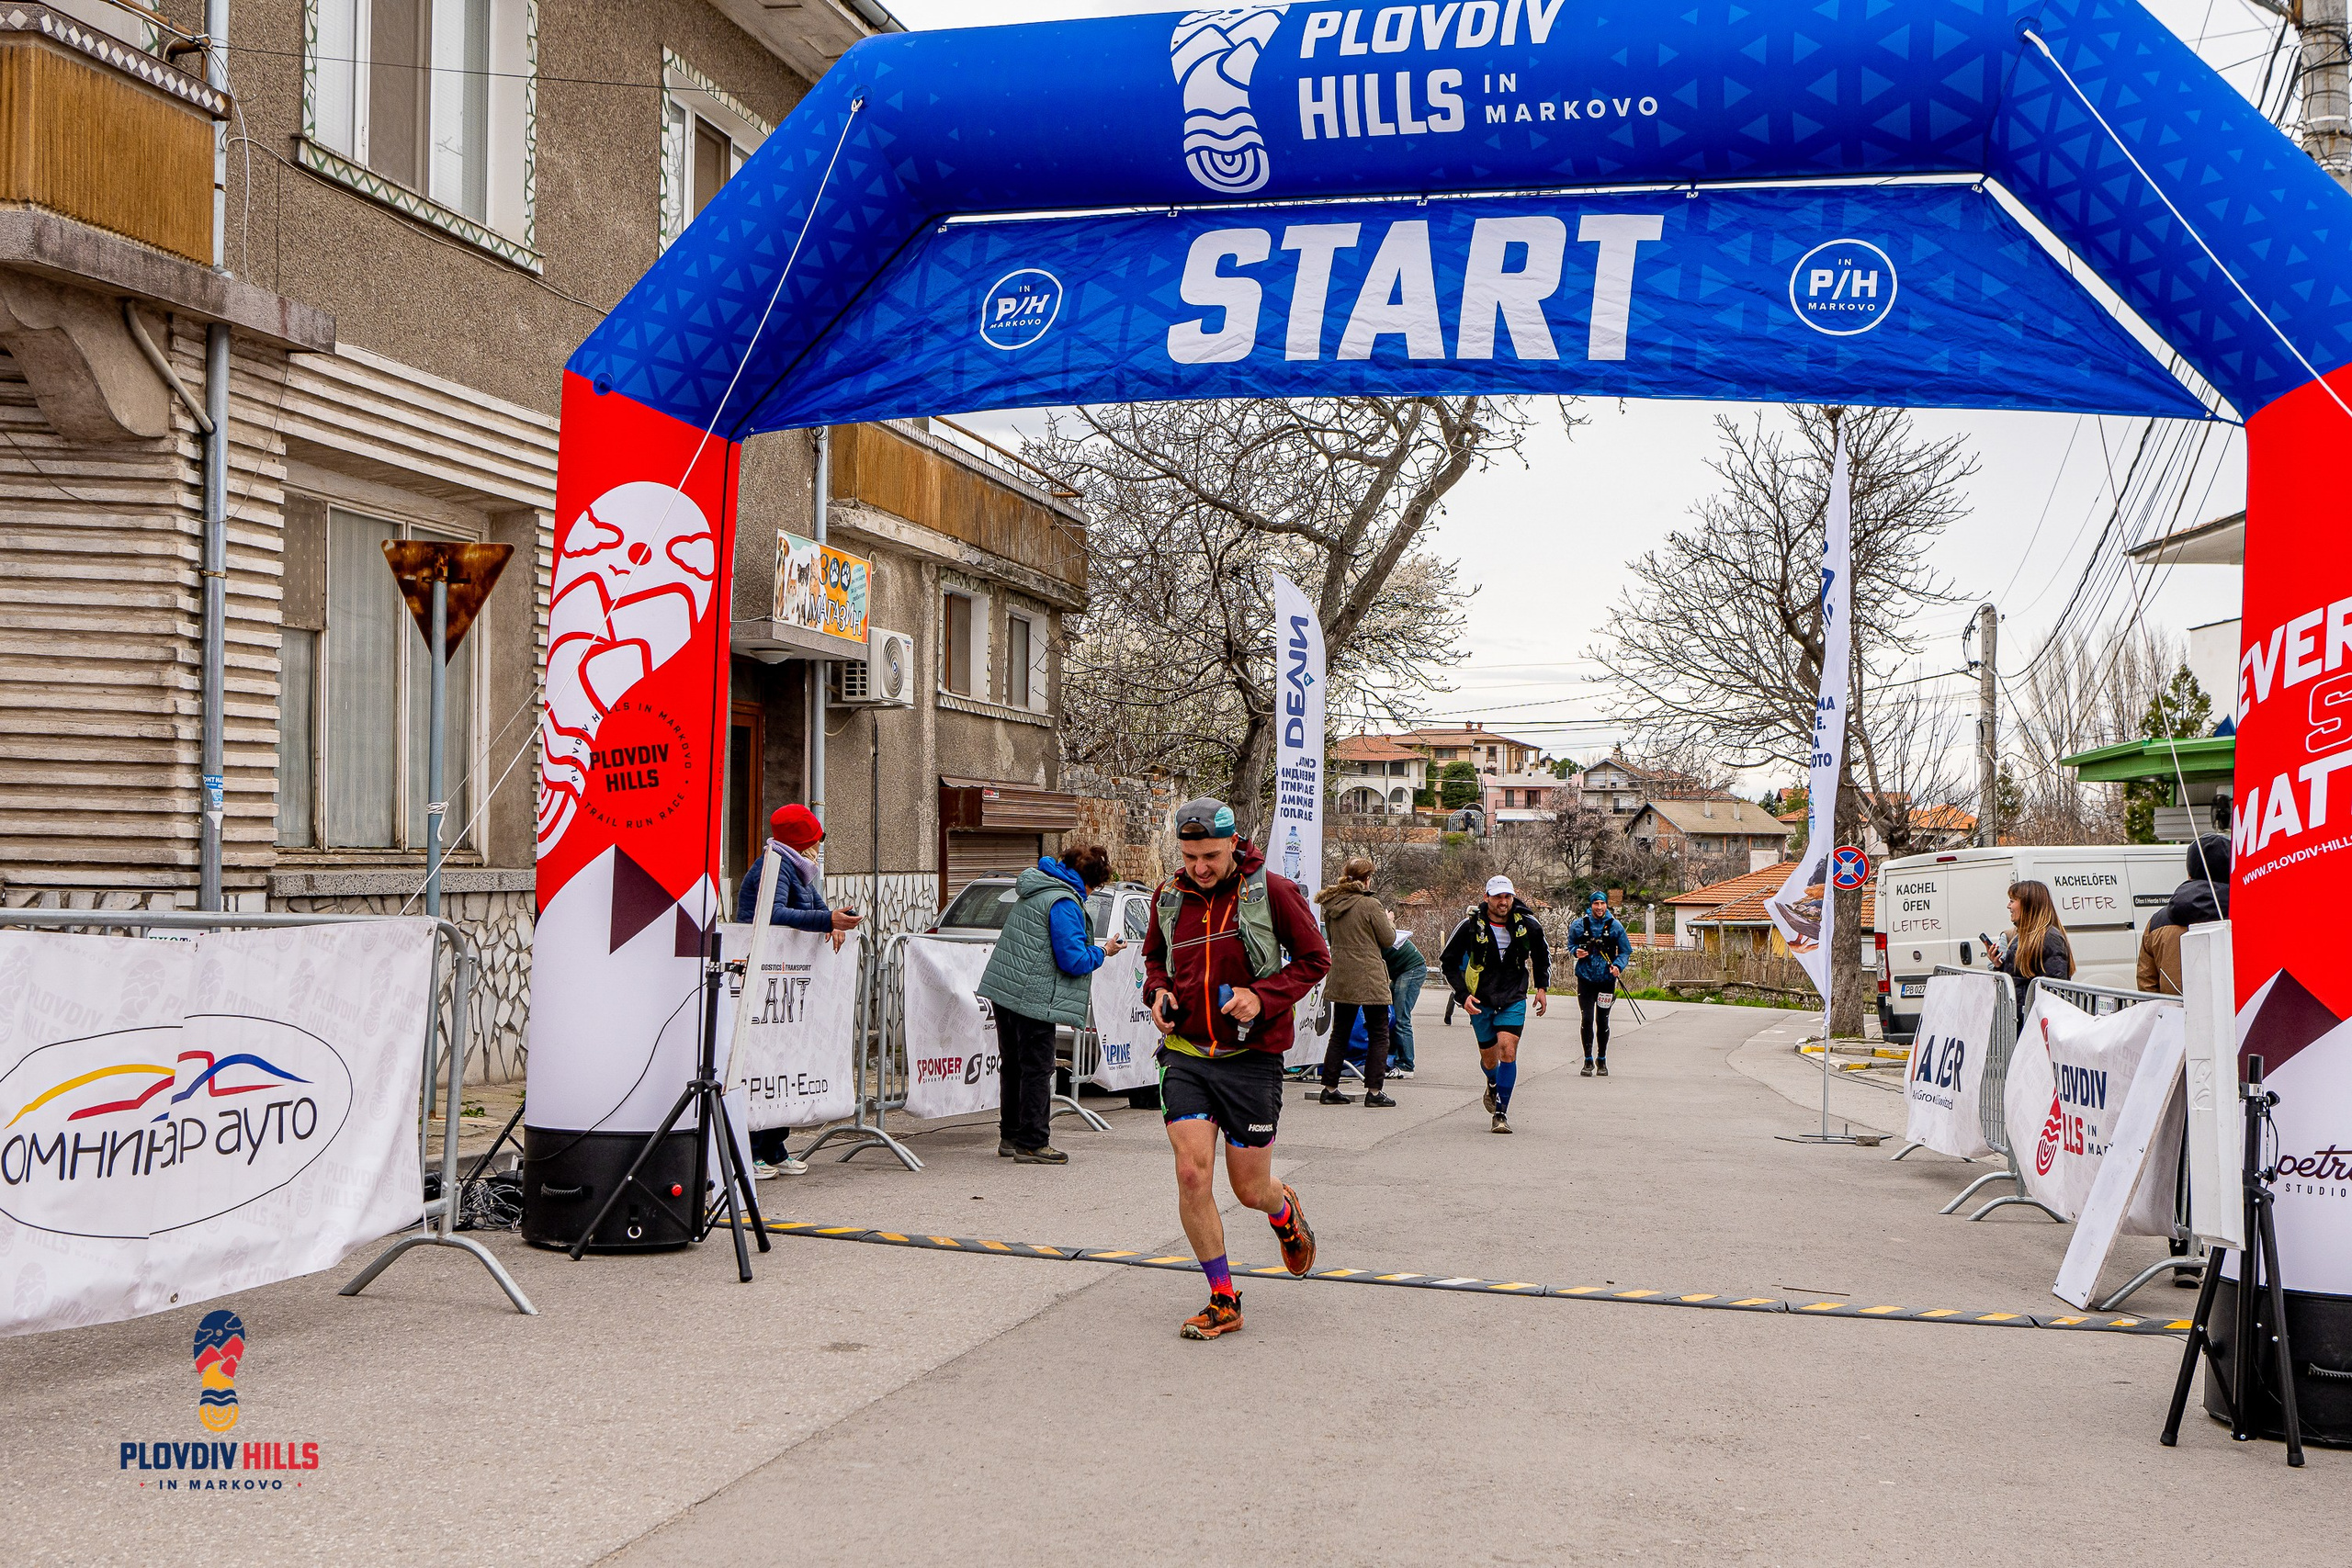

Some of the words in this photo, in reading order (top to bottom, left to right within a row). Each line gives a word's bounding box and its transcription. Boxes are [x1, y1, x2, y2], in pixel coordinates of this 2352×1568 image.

[1299, 0, 1564, 59] PLOVDIV
[1484, 73, 1517, 94] IN
[1298, 68, 1464, 140] HILLS
[1486, 96, 1659, 124] MARKOVO
[1019, 285, 1031, 293] IN
[1167, 214, 1665, 365] START
[1809, 269, 1878, 300] P/H
[995, 294, 1050, 321] P/H
[1808, 302, 1875, 311] MARKOVO
[989, 318, 1042, 329] MARKOVO
[808, 593, 862, 636] МАГАЗИН
[571, 724, 590, 783] PLOVDIV
[592, 703, 629, 723] HILLS
[639, 703, 652, 713] IN
[659, 711, 692, 770] MARKOVO
[589, 743, 669, 771] PLOVDIV
[605, 769, 660, 793] HILLS
[583, 802, 617, 827] TRAIL
[626, 818, 653, 829] RUN
[659, 793, 684, 820] RACE
[1895, 882, 1938, 896] KACHEL
[2054, 873, 2118, 887] KACHELÖFEN
[1903, 899, 1931, 912] ÖFEN
[2061, 896, 2118, 910] LEITER
[1893, 918, 1942, 933] LEITER
[752, 977, 811, 1025] ANT
[917, 1056, 962, 1085] SPONSER
[2087, 1123, 2098, 1137] IN
[2285, 1182, 2346, 1198] STUDIO
